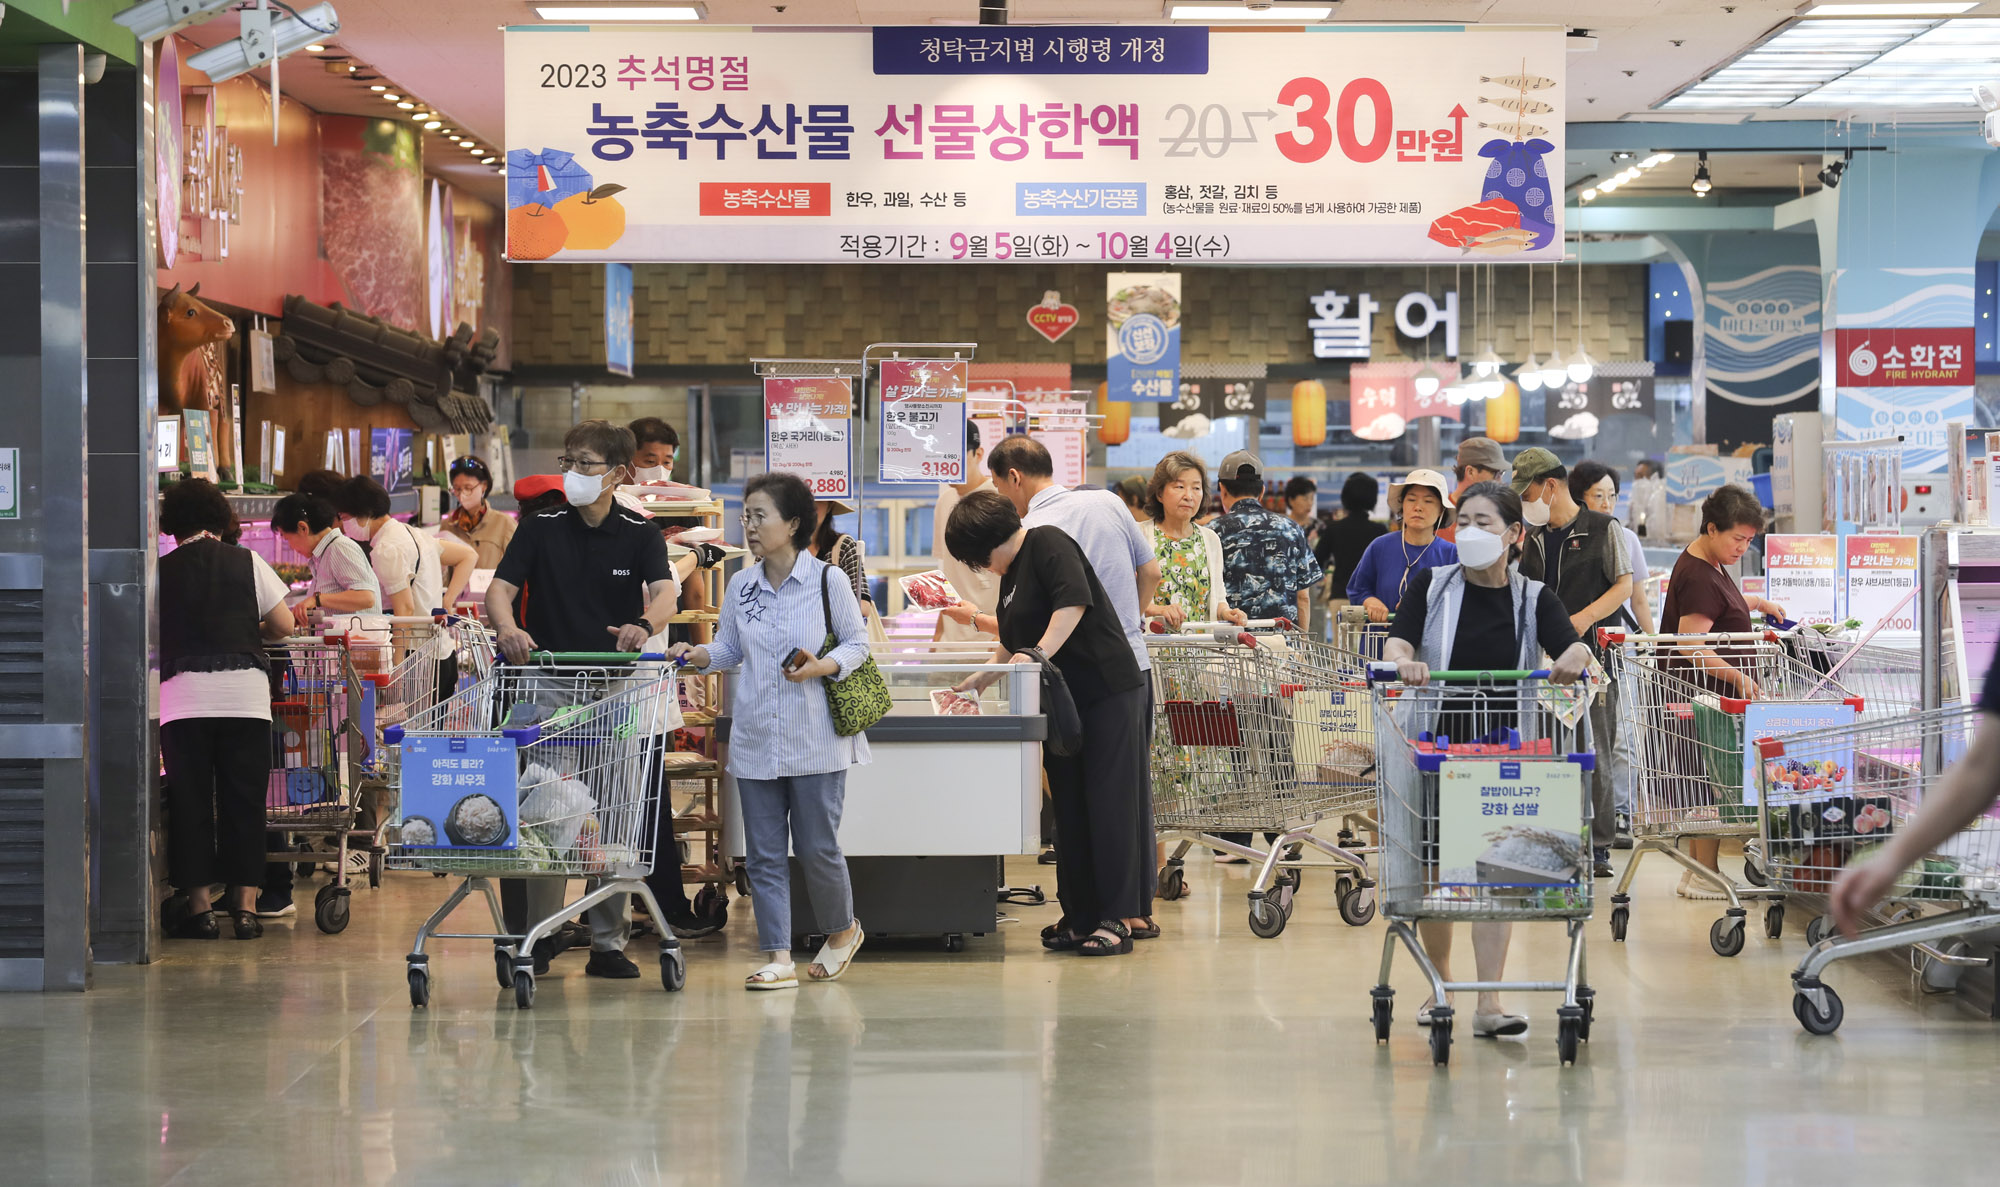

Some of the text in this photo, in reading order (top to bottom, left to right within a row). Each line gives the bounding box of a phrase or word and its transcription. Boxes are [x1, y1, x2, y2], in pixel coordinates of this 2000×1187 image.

[919, 37, 1165, 63] 청탁금지법 시행령 개정
[540, 54, 748, 91] 2023 추석명절
[586, 102, 855, 161] 농축수산물
[874, 102, 1139, 161] 선물상한액
[723, 188, 811, 208] 농축수산물
[1023, 188, 1139, 209] 농축수산가공품
[1165, 185, 1278, 200] 홍삼, 젓갈, 김치 등
[846, 192, 967, 208] 한우, 과일, 수산 등
[1163, 202, 1214, 214] (농수산물을
[1272, 202, 1302, 214] 50%를
[1305, 202, 1325, 214] 넘게
[1326, 202, 1365, 214] 사용하여
[1367, 202, 1397, 214] 가공한
[1399, 202, 1421, 214] 제품)
[840, 235, 927, 258] 적용기간
[950, 232, 988, 260] 9월
[995, 232, 1069, 260] 5일(화)
[1096, 232, 1148, 260] 10월
[1155, 232, 1230, 260] 4일(수)
[1034, 314, 1056, 323] CCTV
[1882, 344, 1962, 369] 소화전
[1885, 370, 1959, 379] FIRE HYDRANT
[885, 385, 898, 398] 살
[823, 403, 847, 415] 가격!
[886, 411, 939, 422] 한우 불고기
[771, 431, 788, 442] 한우
[1770, 554, 1781, 565] 살
[1783, 554, 1813, 565] 맛나는
[1850, 555, 1914, 566] 살 맛나는 가격!
[1771, 577, 1781, 587] 한우
[1851, 577, 1863, 587] 한우
[432, 759, 485, 769] 아직도 몰라?
[432, 774, 485, 786] 강화 새우젓
[1480, 786, 1541, 797] 찰밥이냐구?
[1481, 803, 1539, 816] 강화 섬쌀
